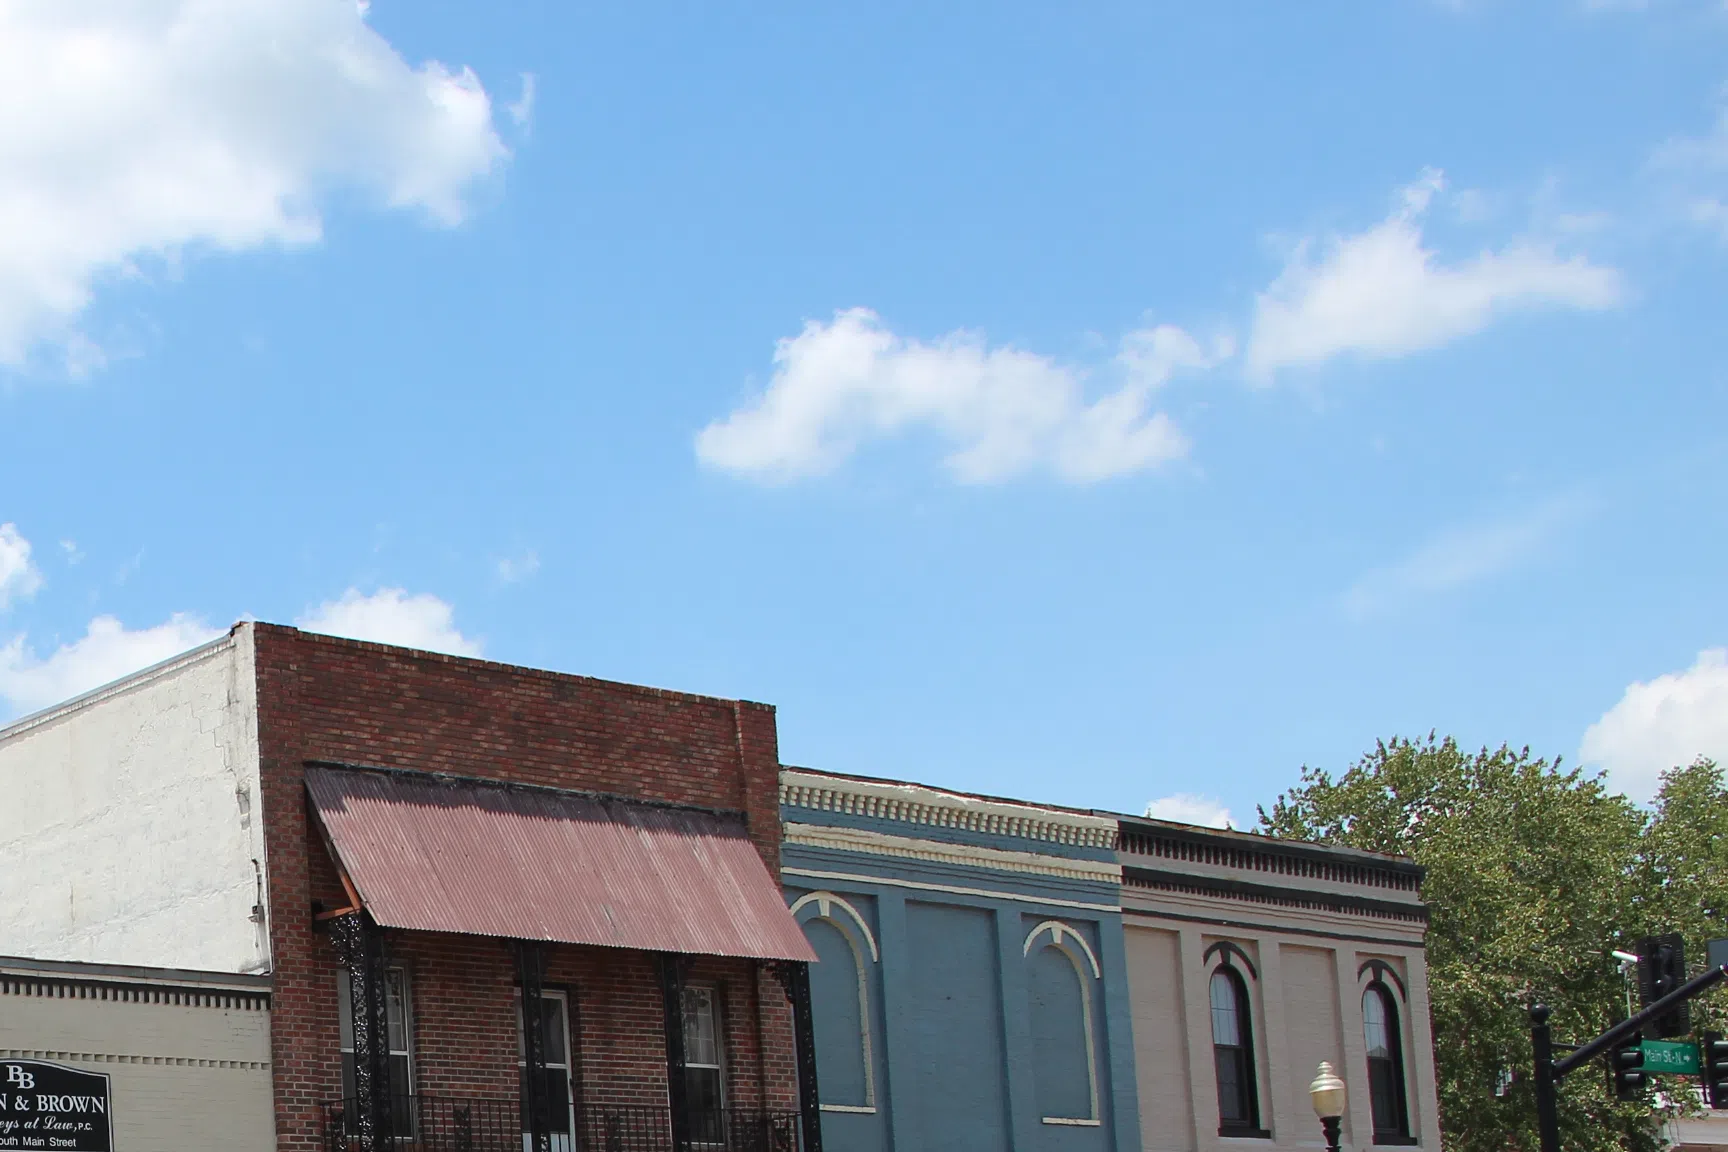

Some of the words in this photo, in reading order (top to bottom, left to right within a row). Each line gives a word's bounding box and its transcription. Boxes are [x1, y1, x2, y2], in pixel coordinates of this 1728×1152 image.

[1644, 1048, 1662, 1062] Main
[5, 1064, 35, 1089] BB
[14, 1095, 30, 1111] &
[36, 1094, 105, 1113] BROWN
[23, 1116, 40, 1129] at
[22, 1136, 45, 1147] Main
[49, 1137, 77, 1148] Street
